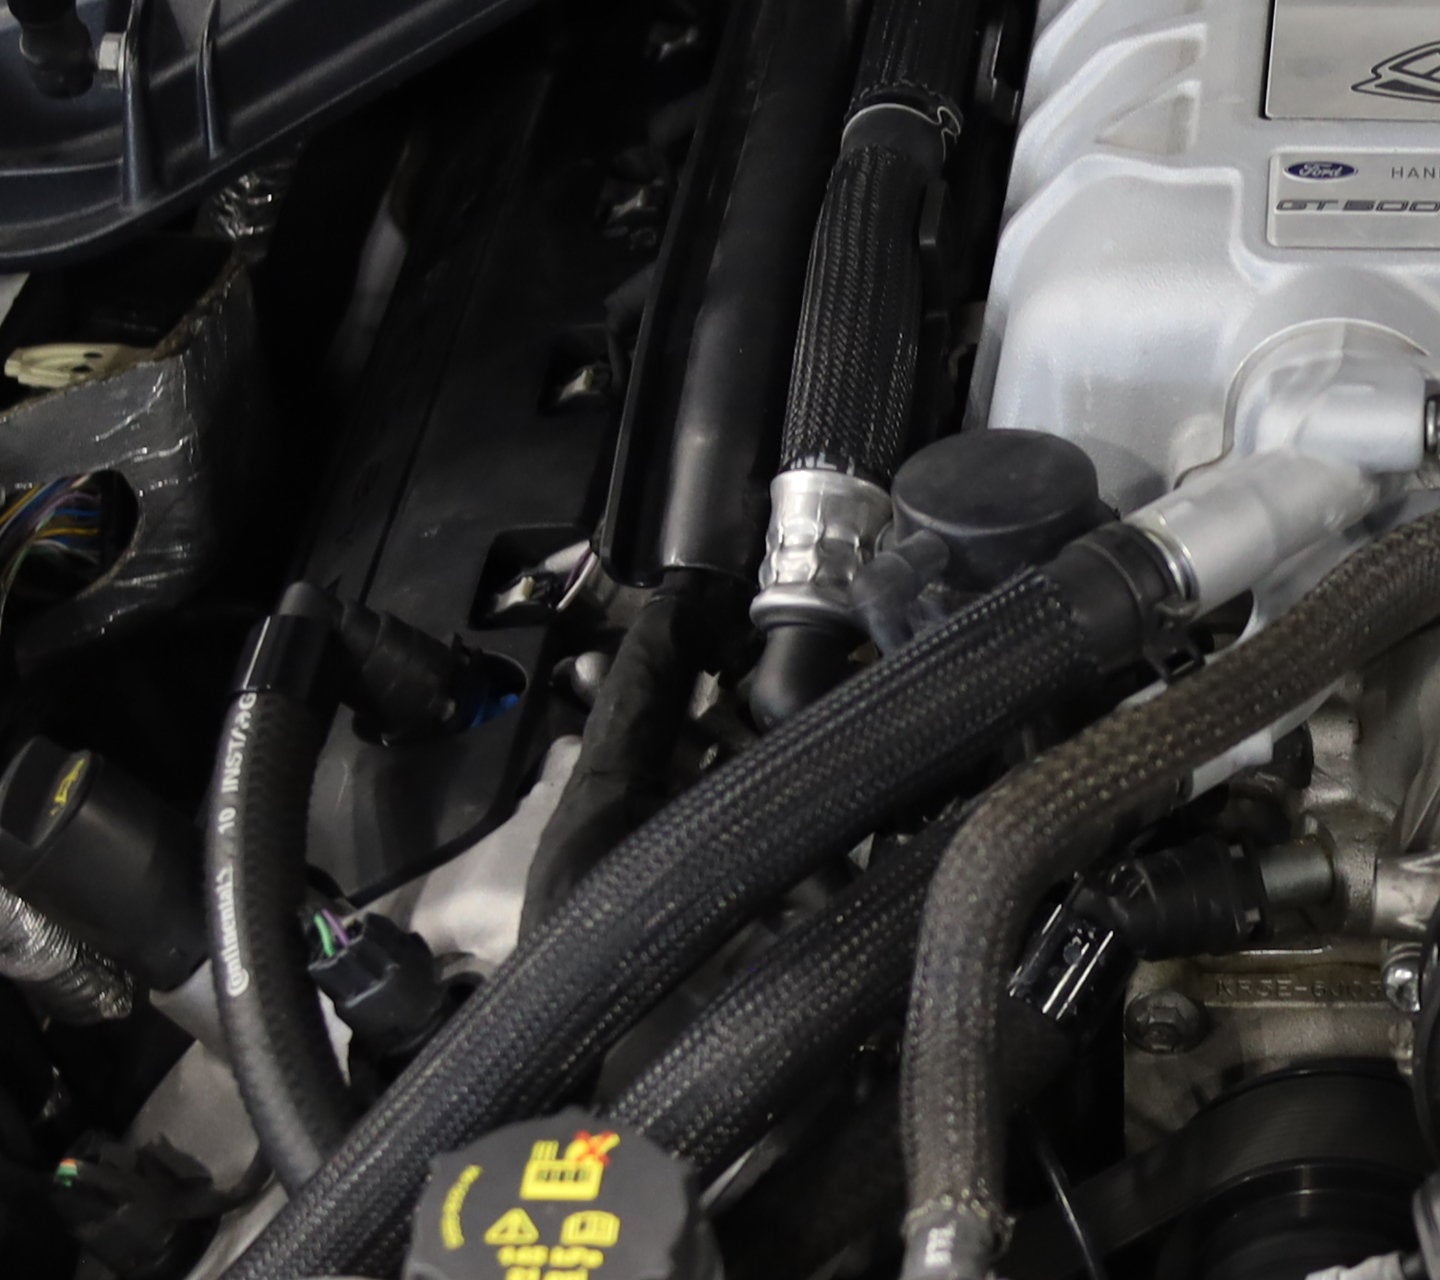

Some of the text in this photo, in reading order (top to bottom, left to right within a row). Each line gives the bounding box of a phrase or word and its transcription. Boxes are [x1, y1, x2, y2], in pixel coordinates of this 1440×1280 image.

[1299, 161, 1344, 178] Ford
[217, 806, 237, 835] 10
[215, 881, 250, 997] Continental
